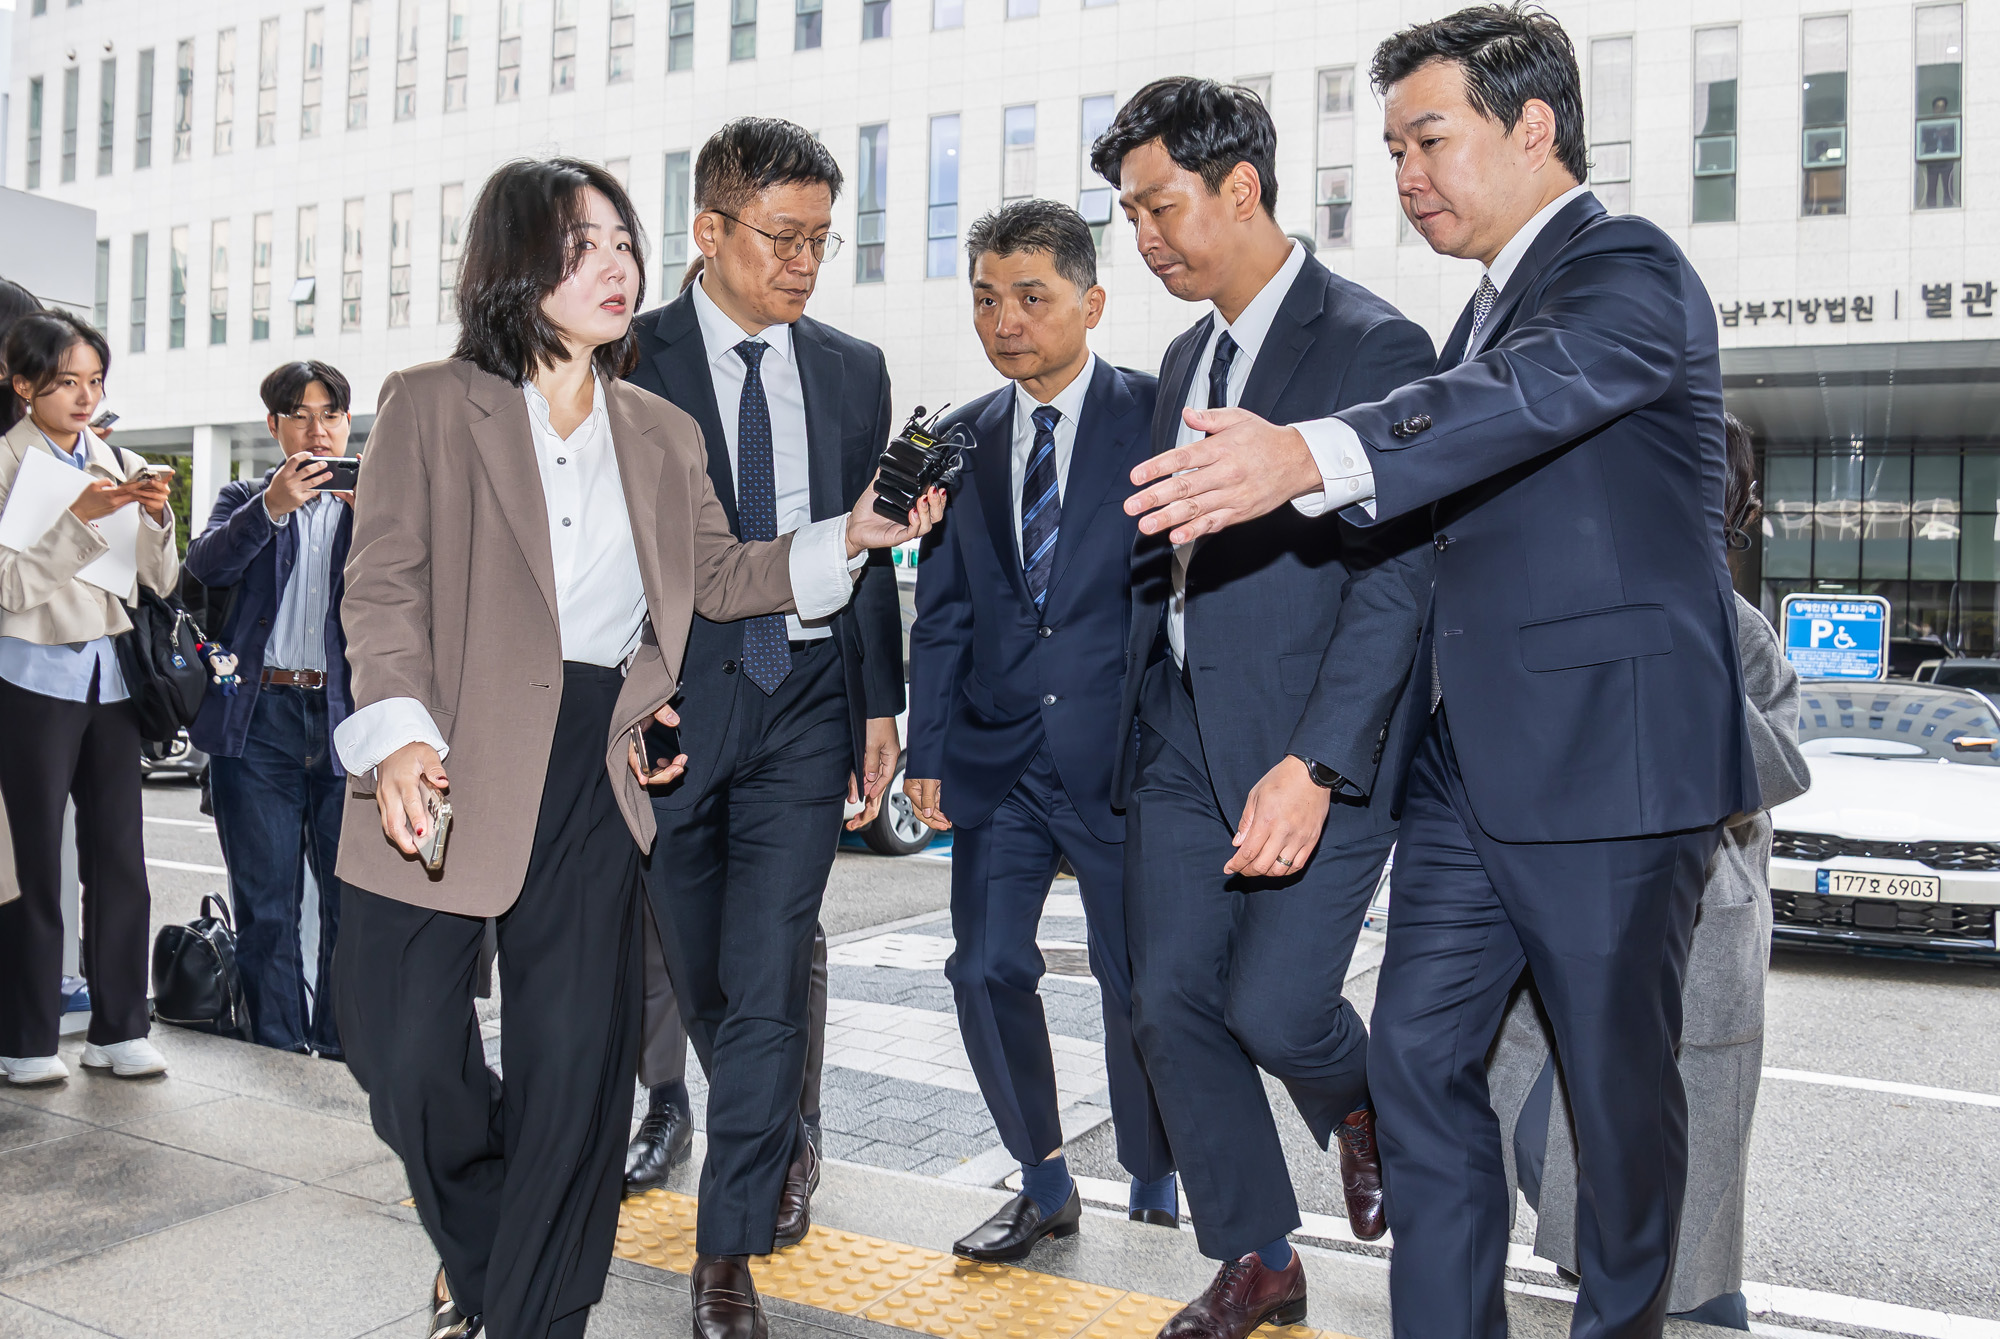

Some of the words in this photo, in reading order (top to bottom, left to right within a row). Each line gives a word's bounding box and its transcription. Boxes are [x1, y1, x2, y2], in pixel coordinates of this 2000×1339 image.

[1719, 295, 1874, 328] 남부지방법원
[1921, 281, 1998, 318] 별관
[1810, 619, 1834, 648] P
[1886, 878, 1934, 898] 6903
